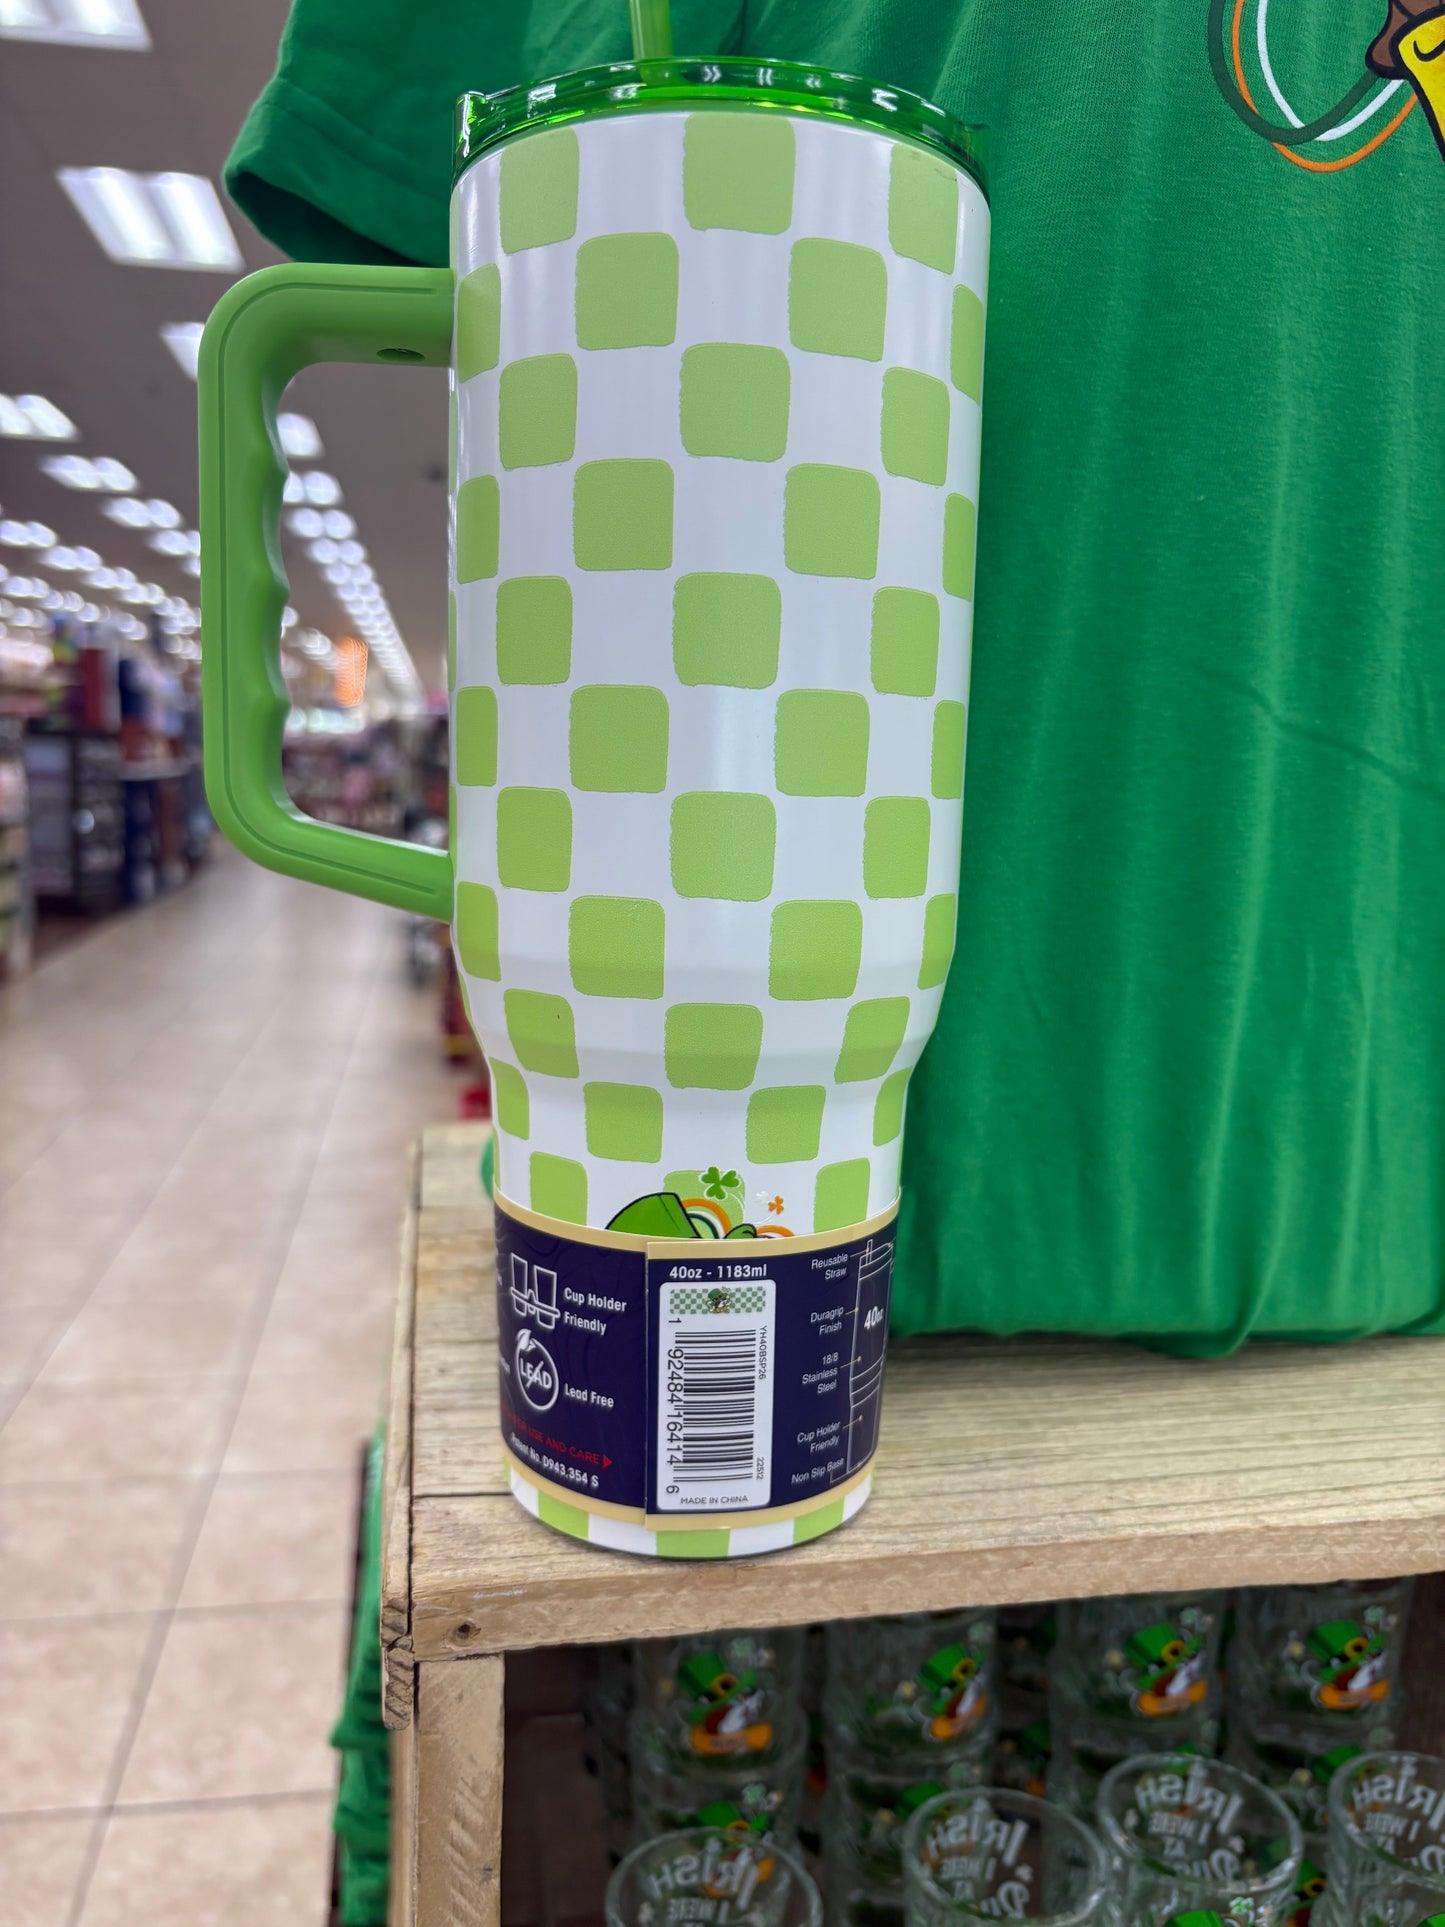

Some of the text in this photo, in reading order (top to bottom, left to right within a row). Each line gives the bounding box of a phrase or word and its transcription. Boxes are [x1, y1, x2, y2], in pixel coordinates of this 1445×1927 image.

[811, 1253, 848, 1269] Reusable
[669, 1266, 702, 1279] 40oz
[718, 1264, 767, 1278] 1183ml
[825, 1267, 847, 1280] Straw
[564, 1287, 627, 1311] Cup Holder
[564, 1311, 607, 1336] Friendly
[810, 1306, 844, 1323] Duragrip
[864, 1305, 884, 1330] 40oz
[819, 1321, 842, 1335] Finish
[822, 1352, 839, 1365] 18/8
[520, 1358, 552, 1389] LEAD
[667, 1348, 684, 1404] 92484
[802, 1367, 838, 1385] Stainless
[564, 1383, 615, 1408] Lead Free
[817, 1379, 837, 1394] Steel
[666, 1411, 683, 1465] 16414
[797, 1421, 841, 1443] Cup Holder
[545, 1437, 567, 1453] AND
[569, 1446, 600, 1464] CARE
[810, 1434, 840, 1454] Friendly
[591, 1474, 599, 1487] S
[791, 1457, 845, 1484] Non Slip Base
[709, 1496, 718, 1504] IN
[720, 1495, 748, 1504] CHINA
